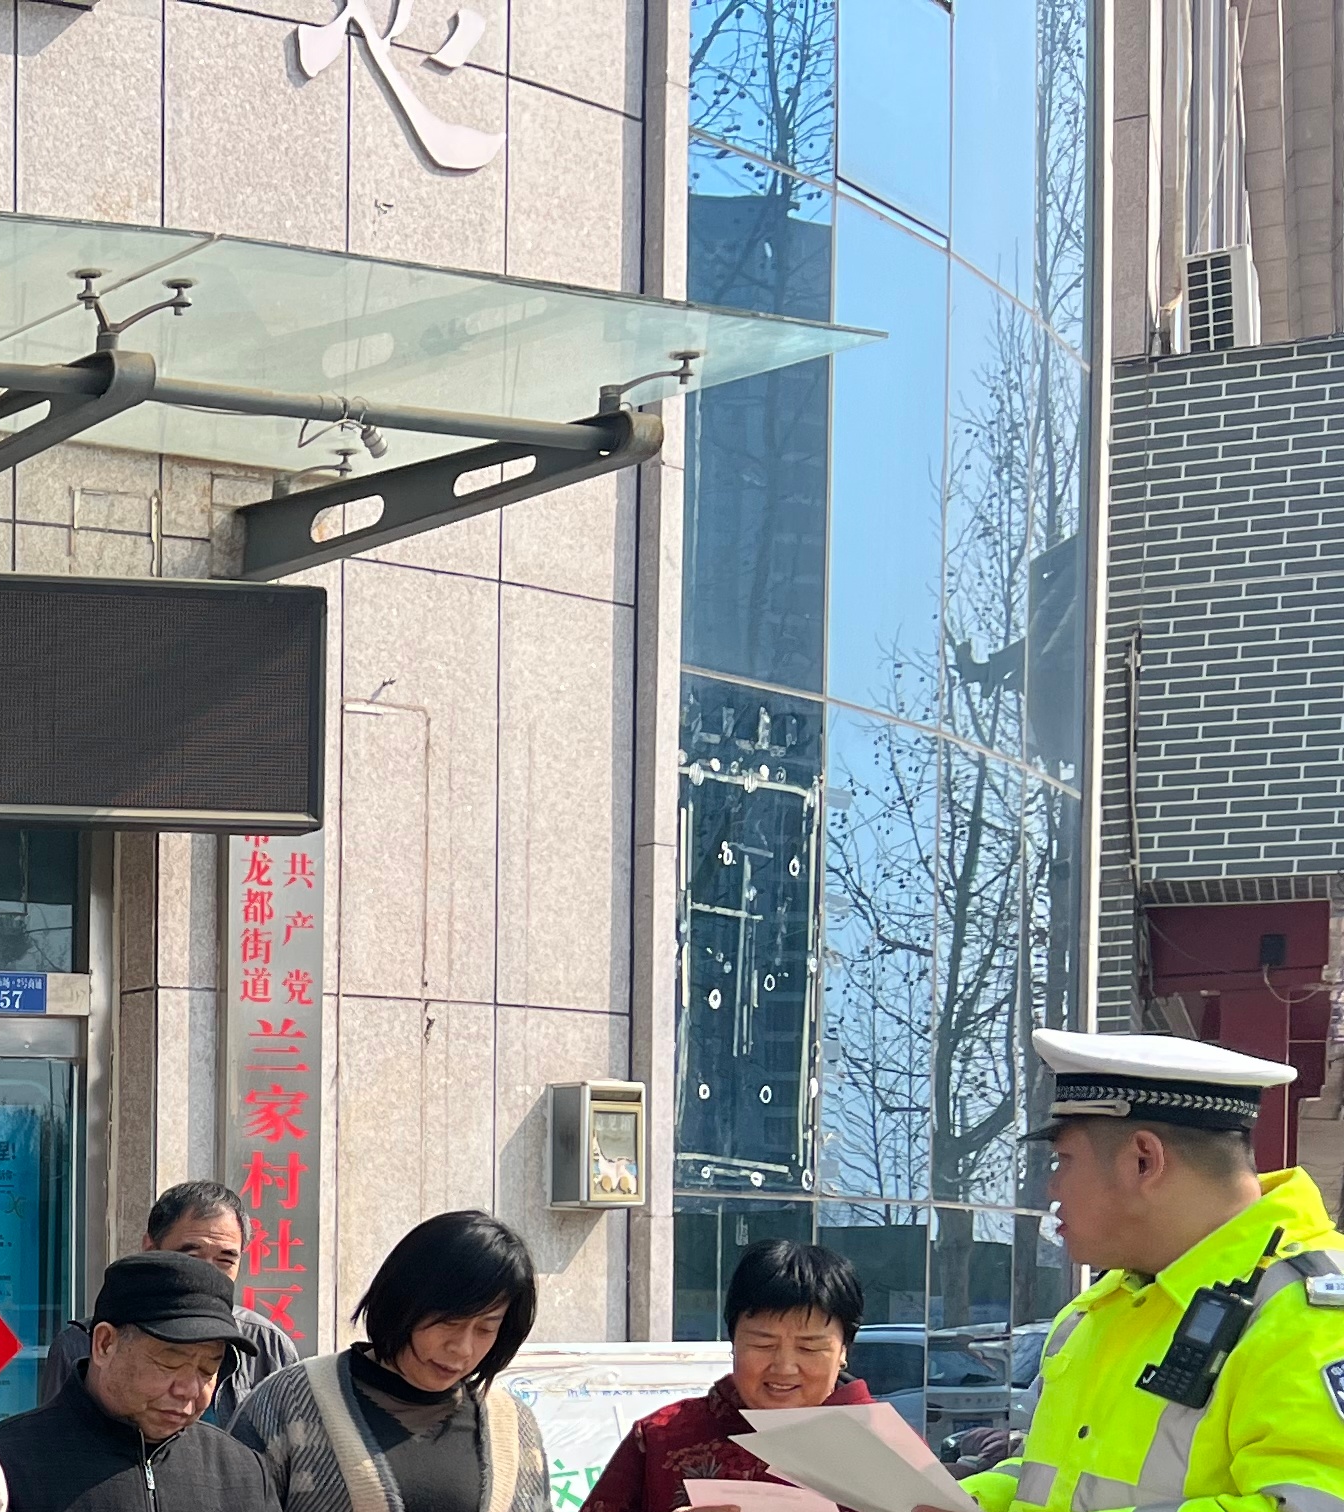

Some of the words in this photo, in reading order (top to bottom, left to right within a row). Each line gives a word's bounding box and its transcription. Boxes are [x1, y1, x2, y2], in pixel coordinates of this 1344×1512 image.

[0, 990, 23, 1009] 57
[282, 852, 316, 1006] 共产党
[238, 1017, 311, 1340] 兰家村社区
